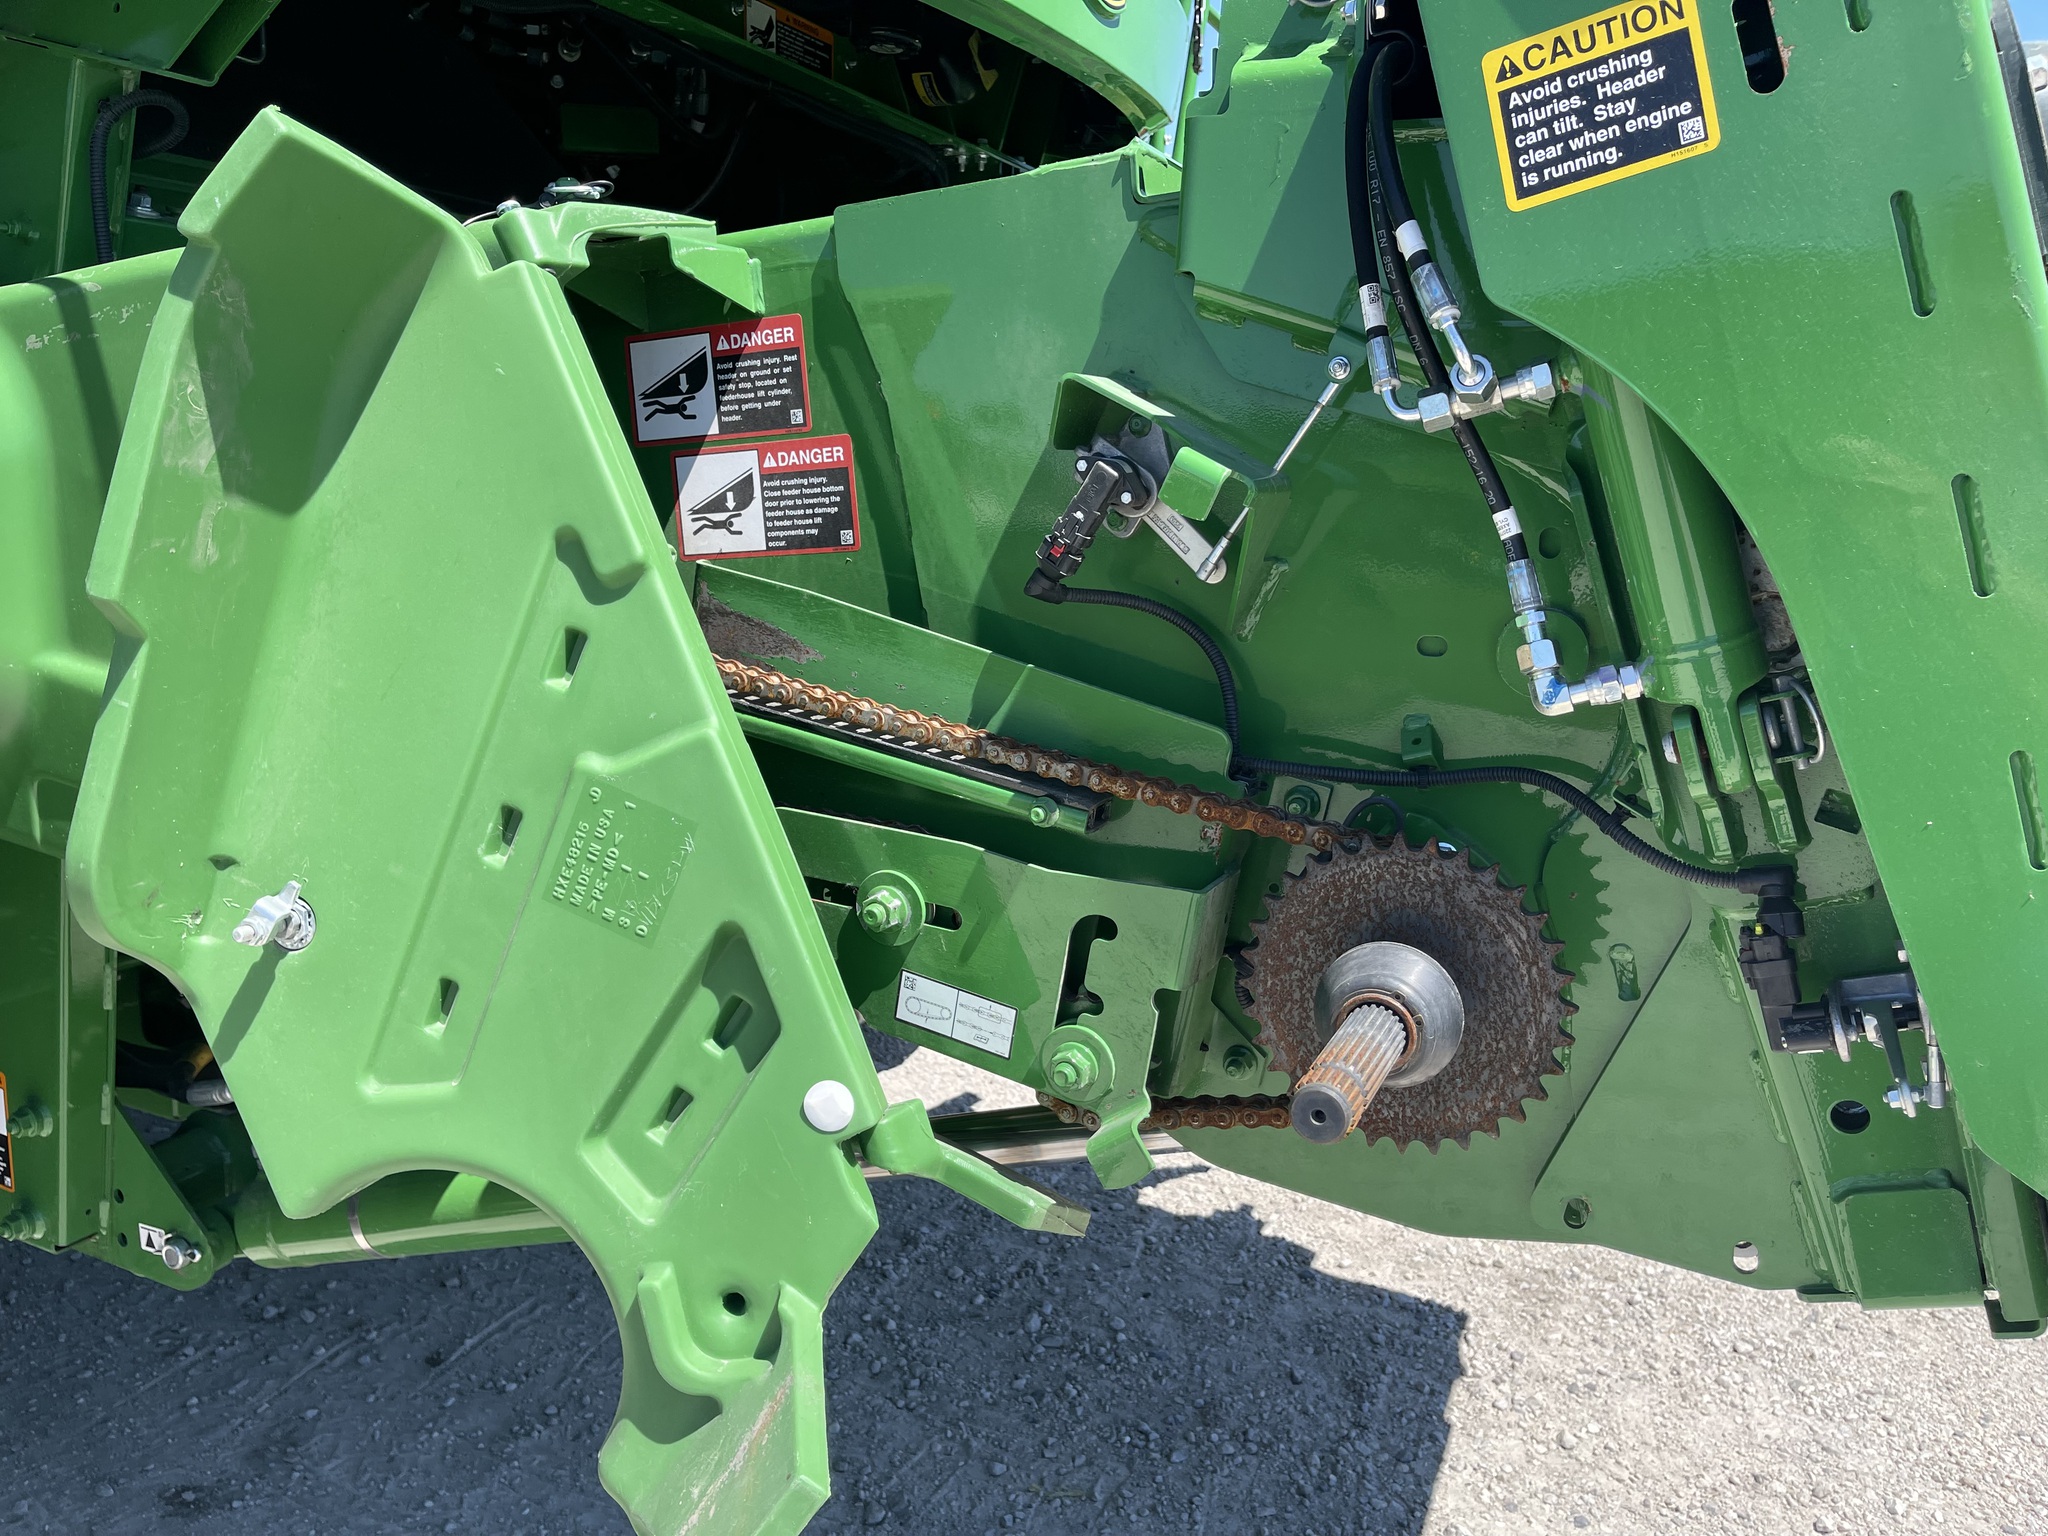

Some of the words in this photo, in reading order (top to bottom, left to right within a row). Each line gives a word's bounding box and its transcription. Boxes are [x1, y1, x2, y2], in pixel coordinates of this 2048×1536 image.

[1522, 0, 1685, 71] CAUTION
[1508, 76, 1562, 109] Avoid
[1567, 49, 1653, 88] crushing
[1511, 94, 1587, 129] injuries.
[1596, 64, 1666, 99] Header
[1515, 126, 1554, 148] can
[1553, 114, 1584, 136] tilt.
[1593, 97, 1637, 122] Stay
[1518, 143, 1564, 168] clear
[1569, 124, 1621, 151] when
[1625, 101, 1692, 132] engine
[1521, 171, 1539, 188] is
[1543, 146, 1623, 181] running.
[1370, 180, 1381, 204] R17
[1377, 229, 1388, 247] EN
[1382, 255, 1397, 280] 857
[1392, 289, 1406, 313] 1SC
[730, 327, 794, 349] DANGER
[1409, 335, 1423, 351] DN
[716, 362, 733, 370] Avoid
[735, 358, 761, 368] crushing
[763, 356, 781, 366] injury.
[784, 354, 798, 362] Rest
[717, 372, 737, 381] header
[750, 368, 771, 378] ground
[718, 383, 736, 392] safety
[738, 381, 753, 390] stop,
[755, 378, 777, 387] located
[719, 391, 755, 401] feederhouse
[767, 388, 793, 398] cylinder,
[720, 403, 739, 412] before
[741, 402, 762, 411] getting
[721, 414, 743, 422] header.
[778, 446, 844, 467] DANGER
[763, 479, 780, 487] Avoid
[781, 477, 808, 487] crushing
[809, 476, 828, 485] injury.
[763, 489, 781, 498] Close
[782, 487, 801, 496] feeder
[802, 486, 821, 494] house
[822, 484, 844, 493] bottom
[780, 498, 795, 507] prior
[802, 496, 829, 506] lowering
[765, 509, 784, 518] feeder
[785, 508, 804, 516] house
[814, 506, 838, 515] damage
[774, 518, 793, 526] feeder
[794, 517, 812, 525] house
[767, 529, 804, 538] components
[805, 528, 818, 536] may
[768, 540, 787, 548] occur.
[1503, 539, 1516, 561] ADE
[594, 808, 615, 840] USA
[587, 842, 602, 863] IN
[569, 864, 594, 907] MADE
[602, 907, 616, 922] M
[618, 916, 631, 929] S
[635, 924, 648, 938] D
